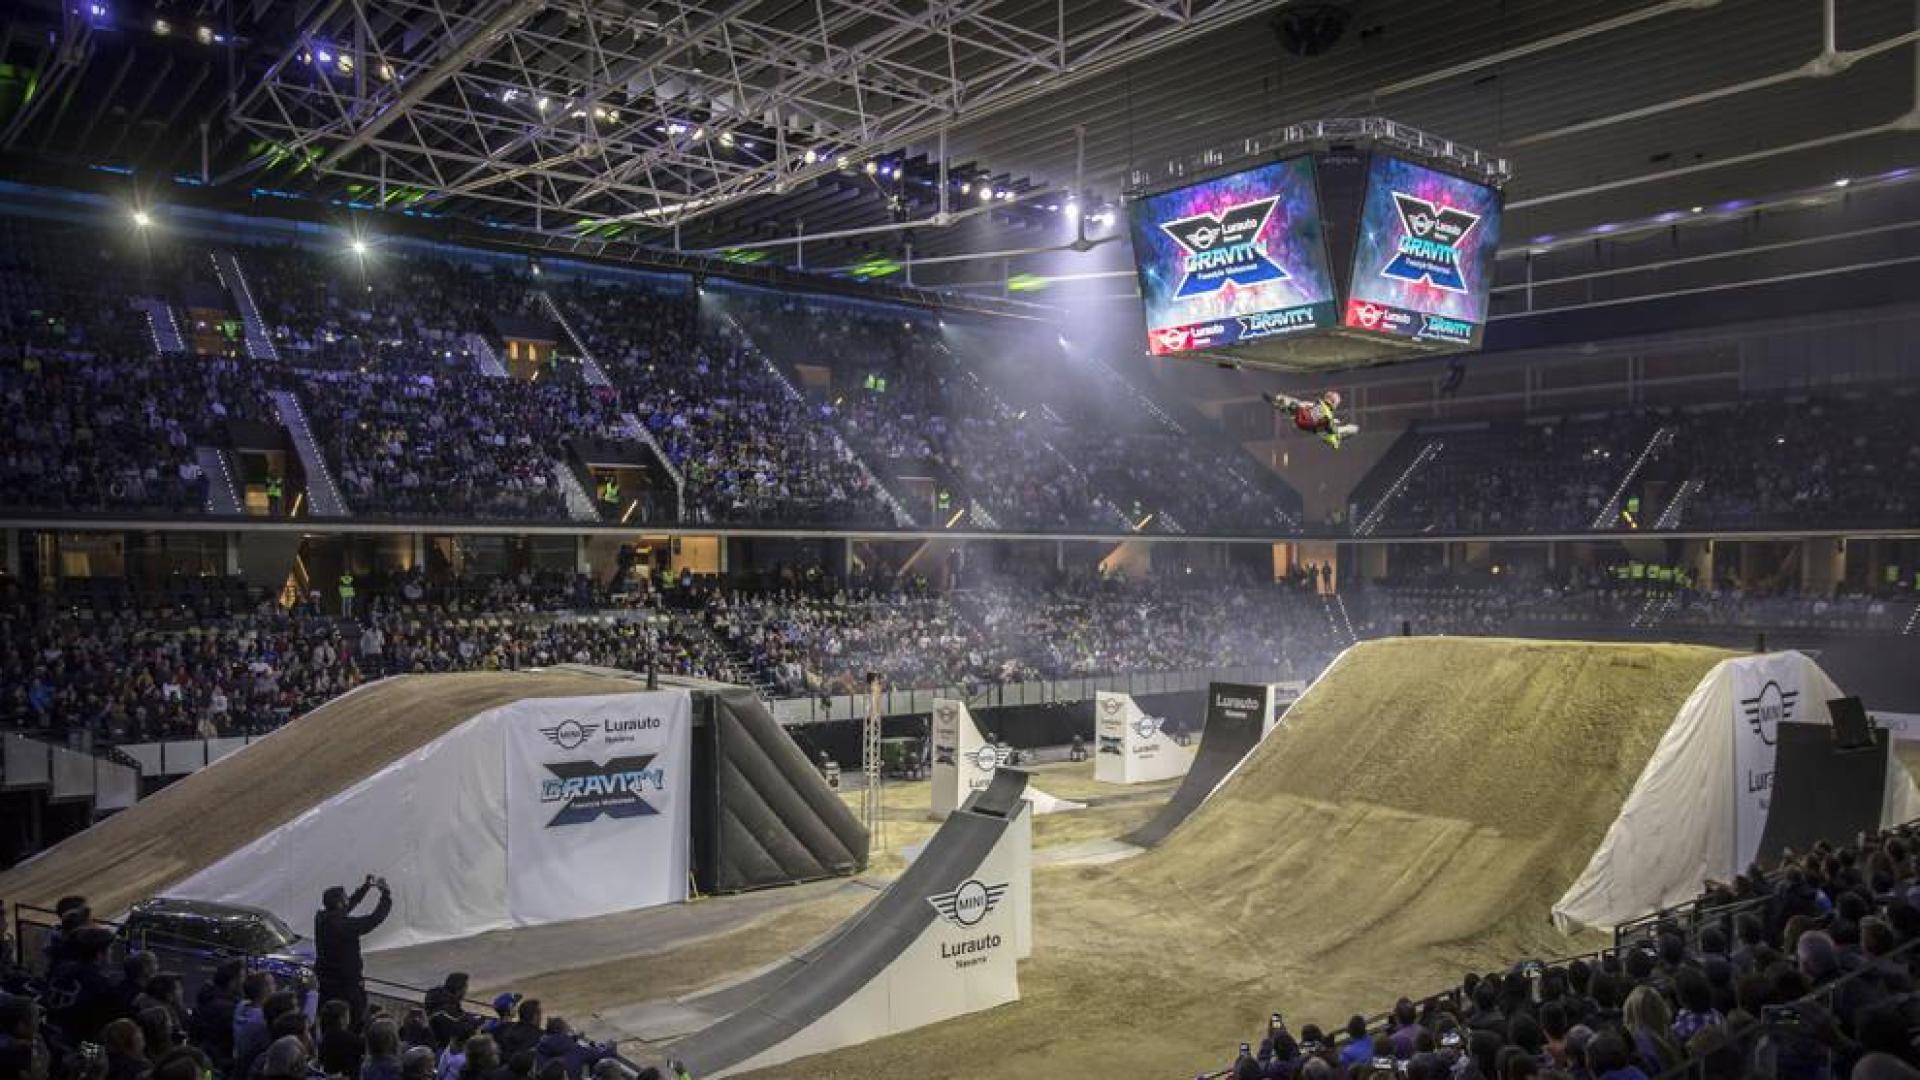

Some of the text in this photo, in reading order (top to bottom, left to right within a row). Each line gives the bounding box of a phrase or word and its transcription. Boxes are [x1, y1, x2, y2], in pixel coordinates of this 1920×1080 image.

[1185, 239, 1268, 272] GRAVITY
[1400, 235, 1463, 265] GRAVITY
[604, 716, 661, 733] Lurauto
[541, 768, 664, 804] GRAVITY
[960, 896, 985, 911] MINI
[941, 933, 1001, 959] Lurauto
